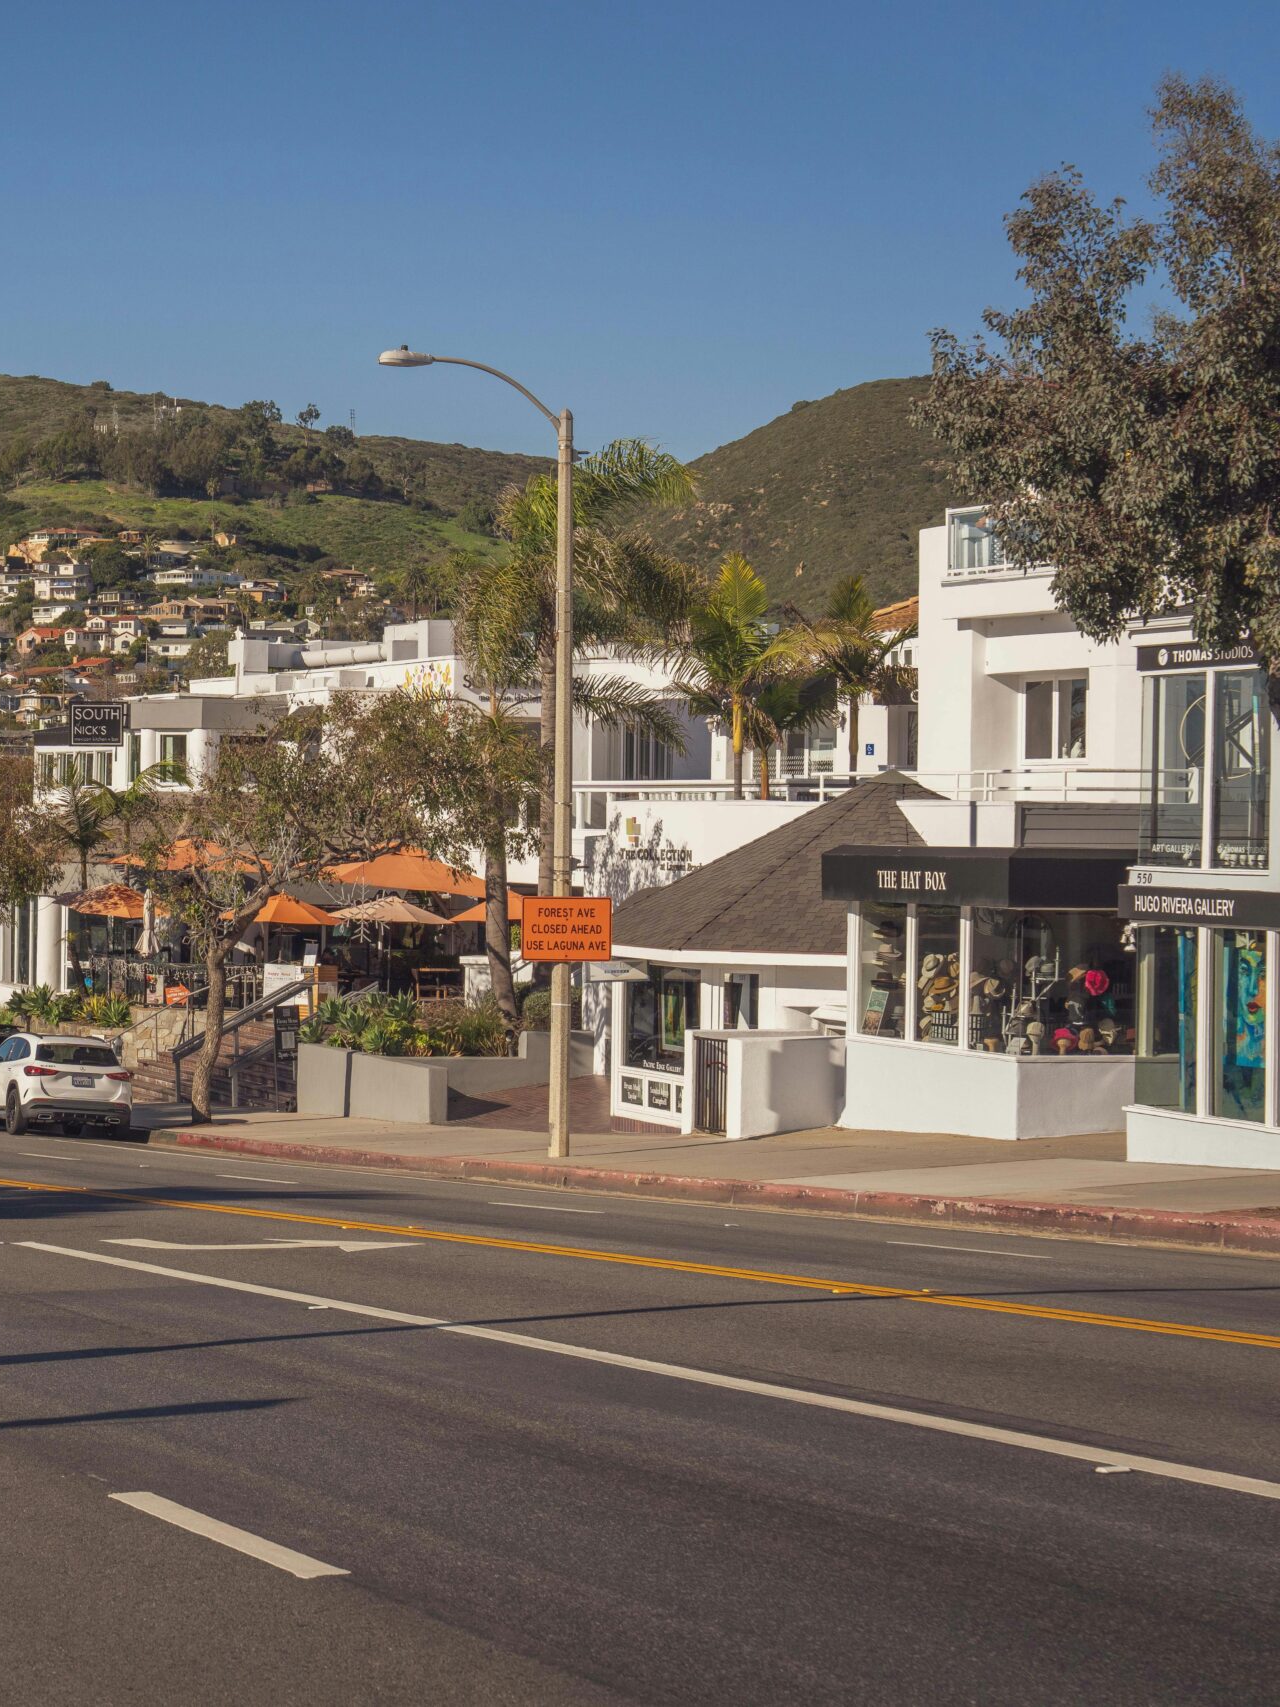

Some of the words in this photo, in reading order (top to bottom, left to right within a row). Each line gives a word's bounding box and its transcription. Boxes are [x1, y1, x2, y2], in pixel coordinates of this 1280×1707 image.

[1172, 648, 1213, 663] THOMAS
[1214, 645, 1254, 660] STUDIOS
[74, 708, 120, 720] SOUTH
[74, 725, 107, 736] NICK'S
[619, 847, 636, 860] THE
[636, 848, 693, 862] COLLECTION
[1151, 844, 1165, 853] ART
[1165, 844, 1195, 854] GALLERY
[877, 869, 898, 889] THE
[900, 870, 922, 890] HAT
[924, 871, 947, 891] BOX
[1136, 872, 1153, 884] 550
[1134, 894, 1161, 913] HUGO
[1161, 895, 1194, 915] RIVERA
[1194, 897, 1235, 917] GALLERY
[537, 907, 574, 918] FOREST
[576, 907, 596, 918] AVE
[531, 923, 568, 934] CLOSED
[570, 924, 602, 935] AHEAD
[526, 940, 544, 951] USE
[547, 940, 585, 951] LAGUNA
[588, 940, 607, 951] AVE
